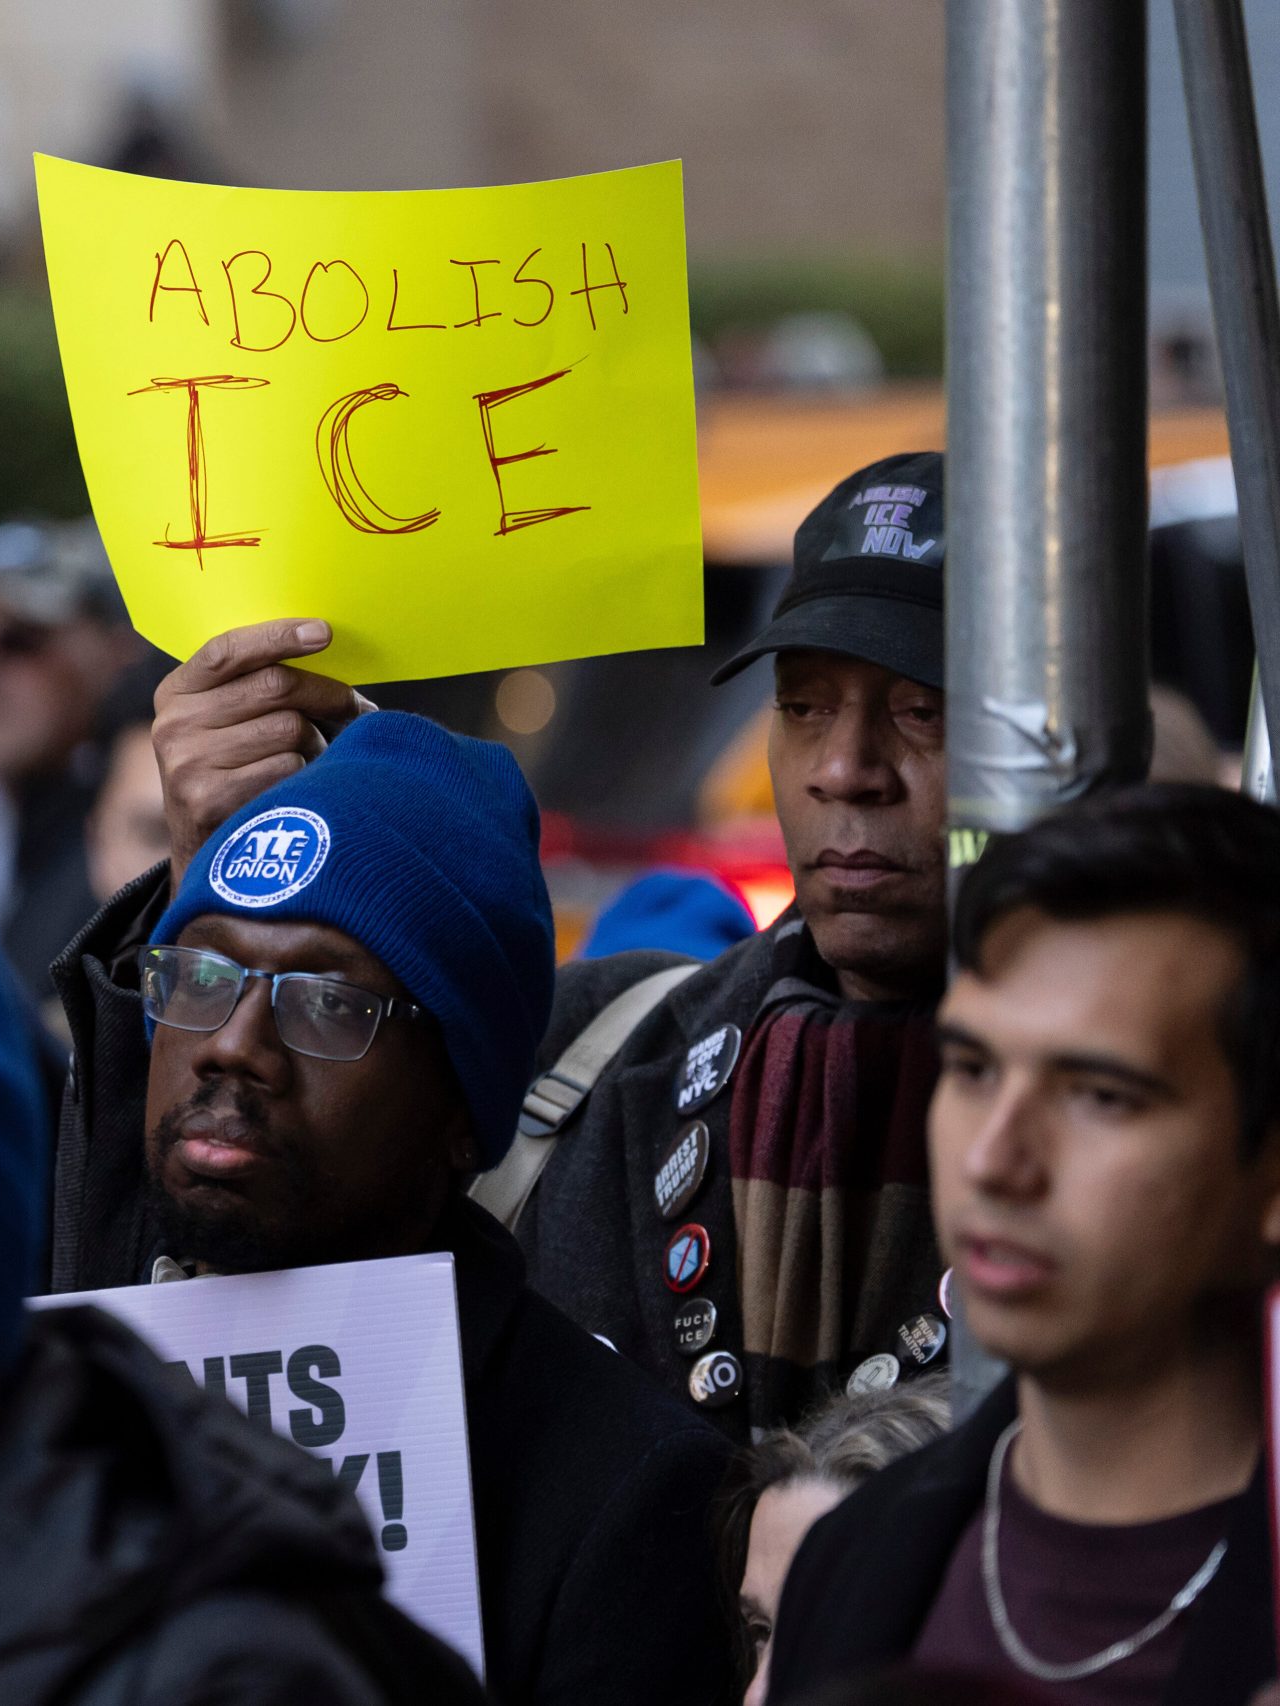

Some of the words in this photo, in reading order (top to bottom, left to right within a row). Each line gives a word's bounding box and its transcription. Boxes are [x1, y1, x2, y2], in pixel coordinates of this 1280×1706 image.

[149, 238, 629, 352] ABOLISH
[126, 358, 591, 572] ICE
[848, 485, 928, 511] ABOLISH
[863, 502, 914, 529] ICE
[860, 526, 937, 560] NOW
[231, 834, 309, 863] ALE
[225, 861, 298, 881] UNION
[696, 1041, 725, 1066] OFF
[678, 1070, 720, 1108] NYC
[654, 1126, 699, 1198] ARREST
[657, 1147, 699, 1207] TRUMP
[674, 1313, 711, 1330] FUCK
[910, 1327, 922, 1339] IS
[915, 1315, 940, 1345] TRUMP
[680, 1330, 704, 1344] ICE
[898, 1323, 926, 1363] TRAITOR
[692, 1362, 737, 1399] NO
